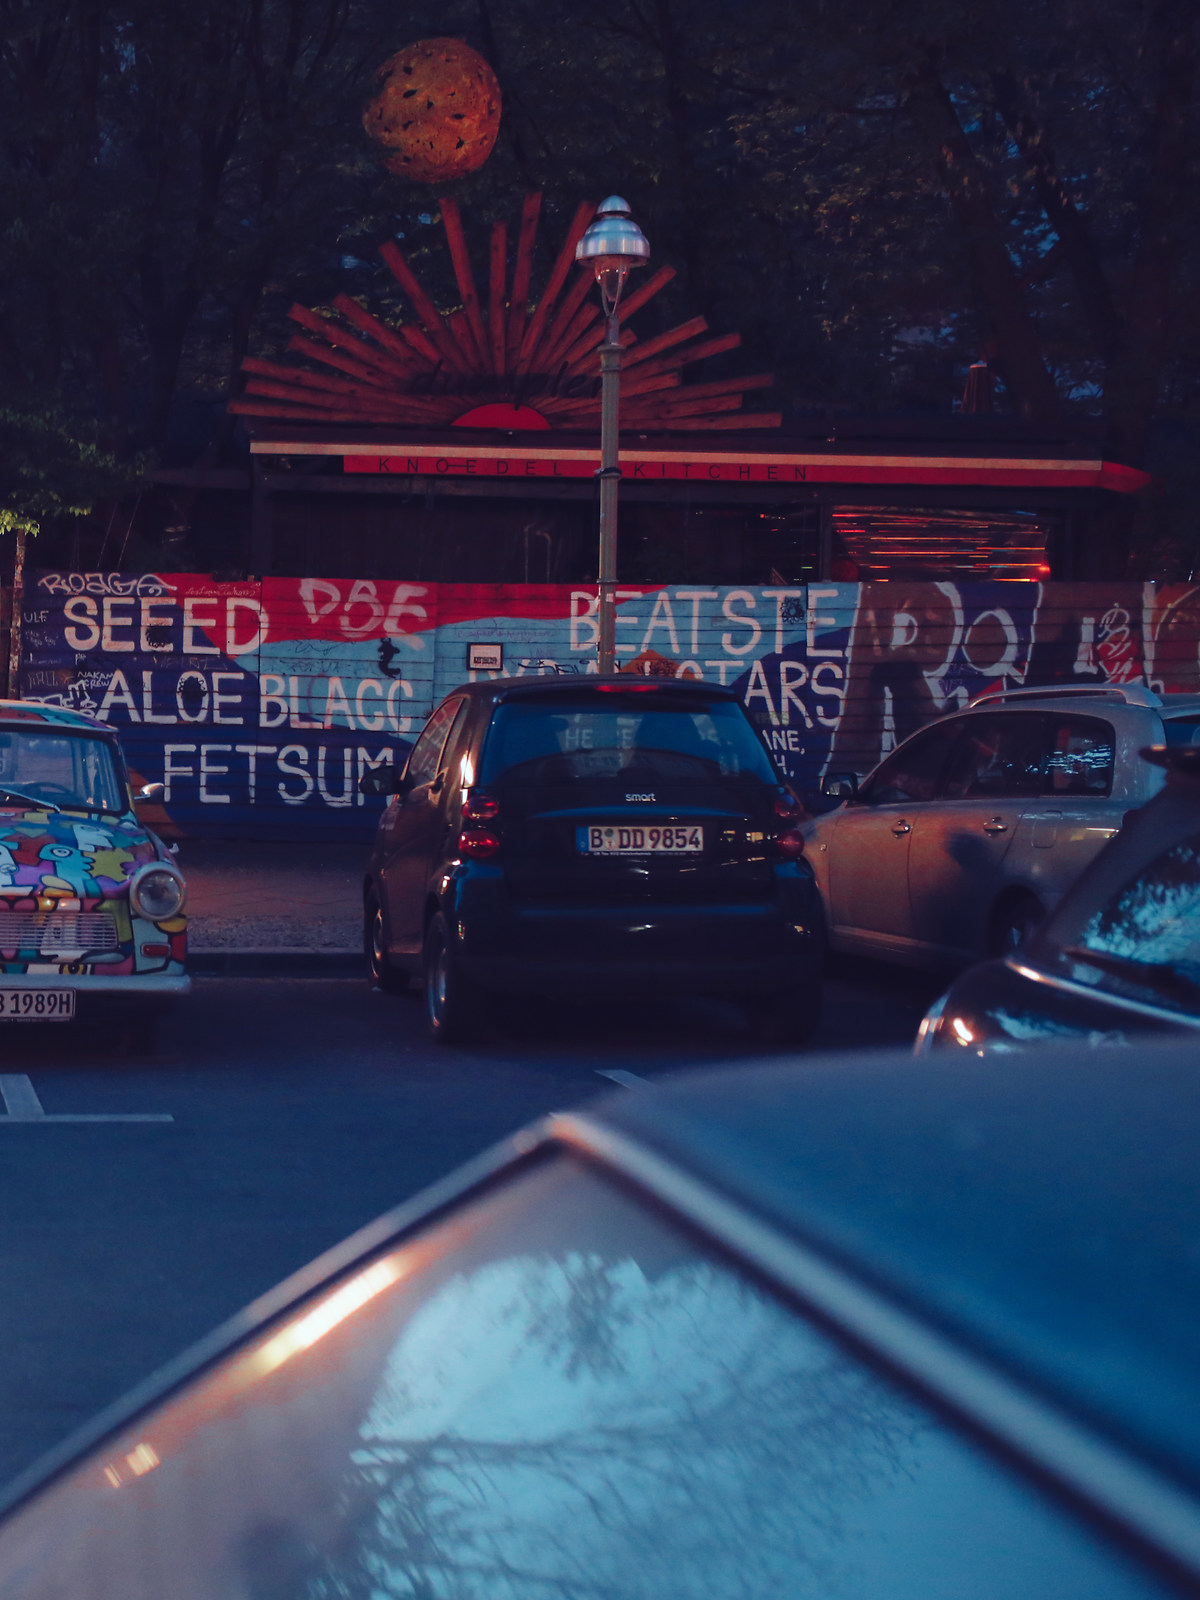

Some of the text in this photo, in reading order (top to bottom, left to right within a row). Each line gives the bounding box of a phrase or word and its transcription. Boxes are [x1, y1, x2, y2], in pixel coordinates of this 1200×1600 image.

[379, 457, 807, 481] KNOEDEL KITCHEN
[63, 596, 271, 656] SEEED
[95, 669, 245, 725] ALOE
[259, 673, 414, 731] BLACC
[163, 743, 395, 809] FETSUM
[625, 793, 657, 802] smart
[649, 828, 701, 849] 9854
[10, 993, 71, 1014] 1989H
